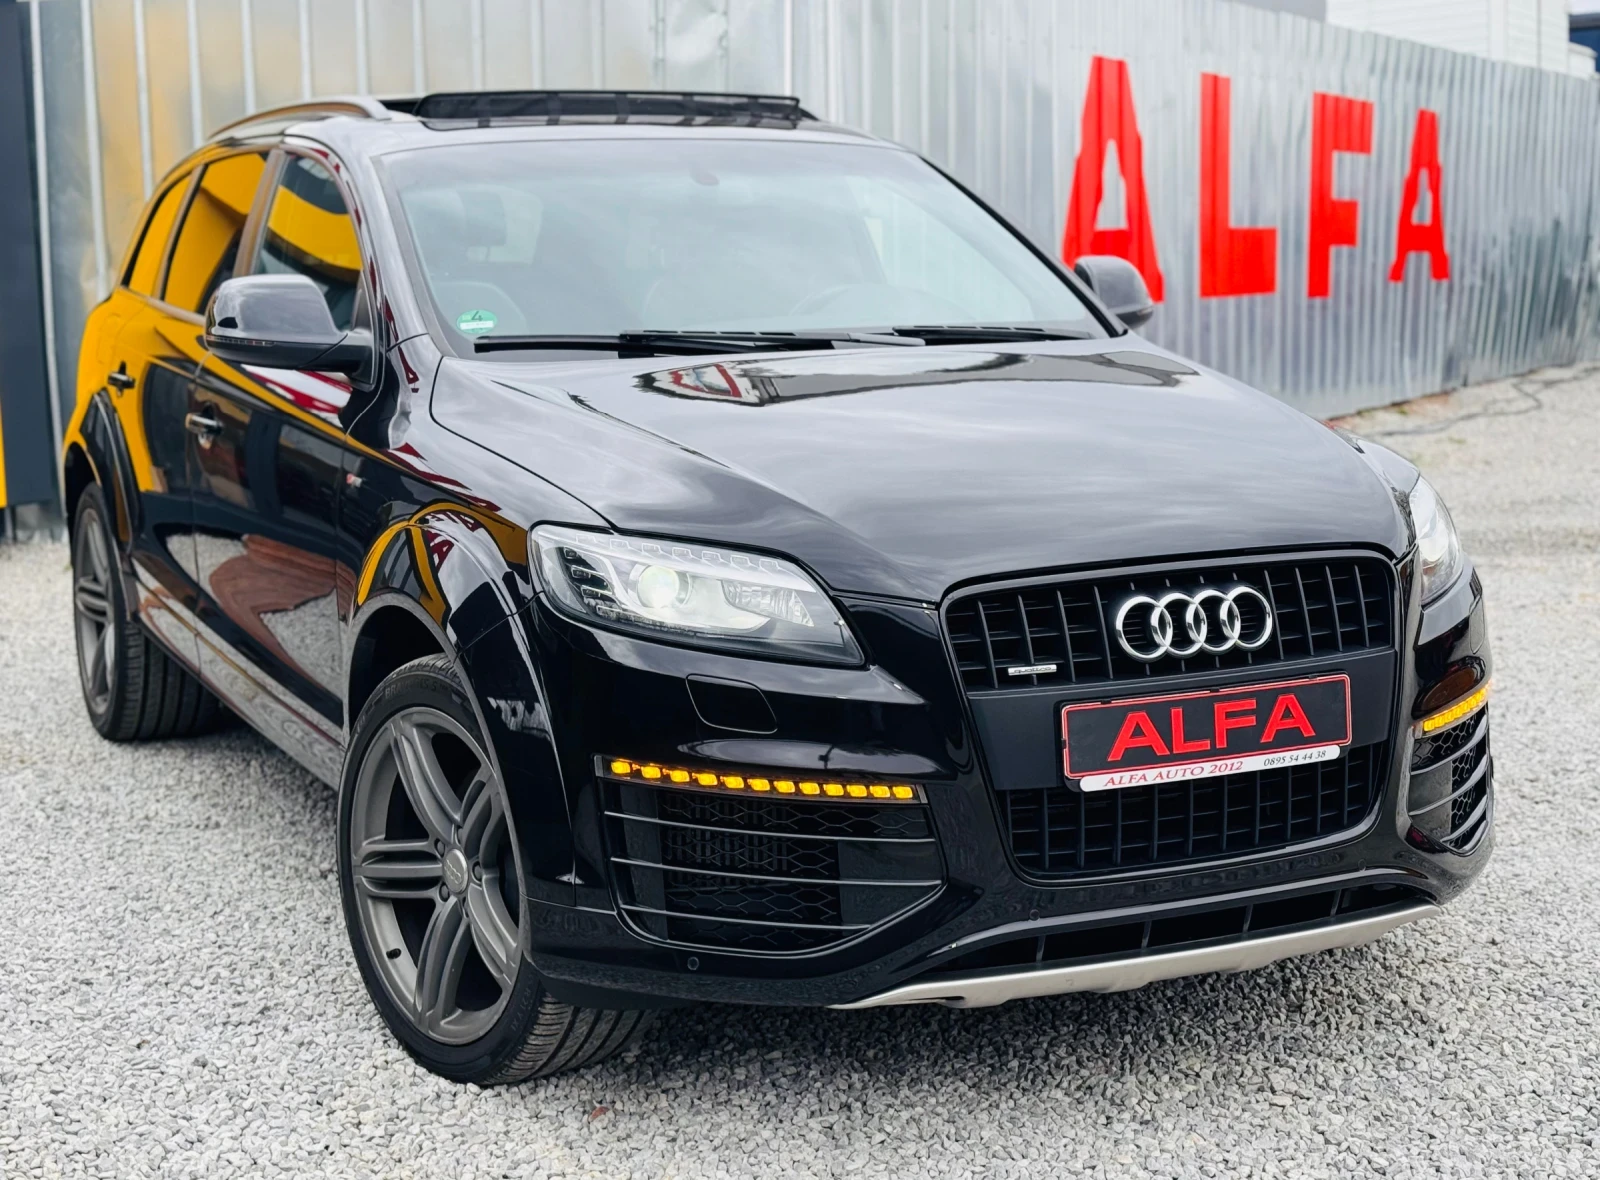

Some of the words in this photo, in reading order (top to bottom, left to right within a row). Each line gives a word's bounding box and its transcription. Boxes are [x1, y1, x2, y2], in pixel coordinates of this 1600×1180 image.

[1062, 55, 1450, 304] ALFA
[470, 310, 484, 321] 4
[1107, 693, 1315, 761] ALFA
[1263, 755, 1287, 766] 0895
[1288, 754, 1300, 763] 54
[1301, 752, 1314, 761] 44
[1315, 749, 1327, 759] 38
[1103, 773, 1148, 787] ALFA
[1152, 766, 1205, 781] AUTO
[1210, 761, 1243, 774] 2012
